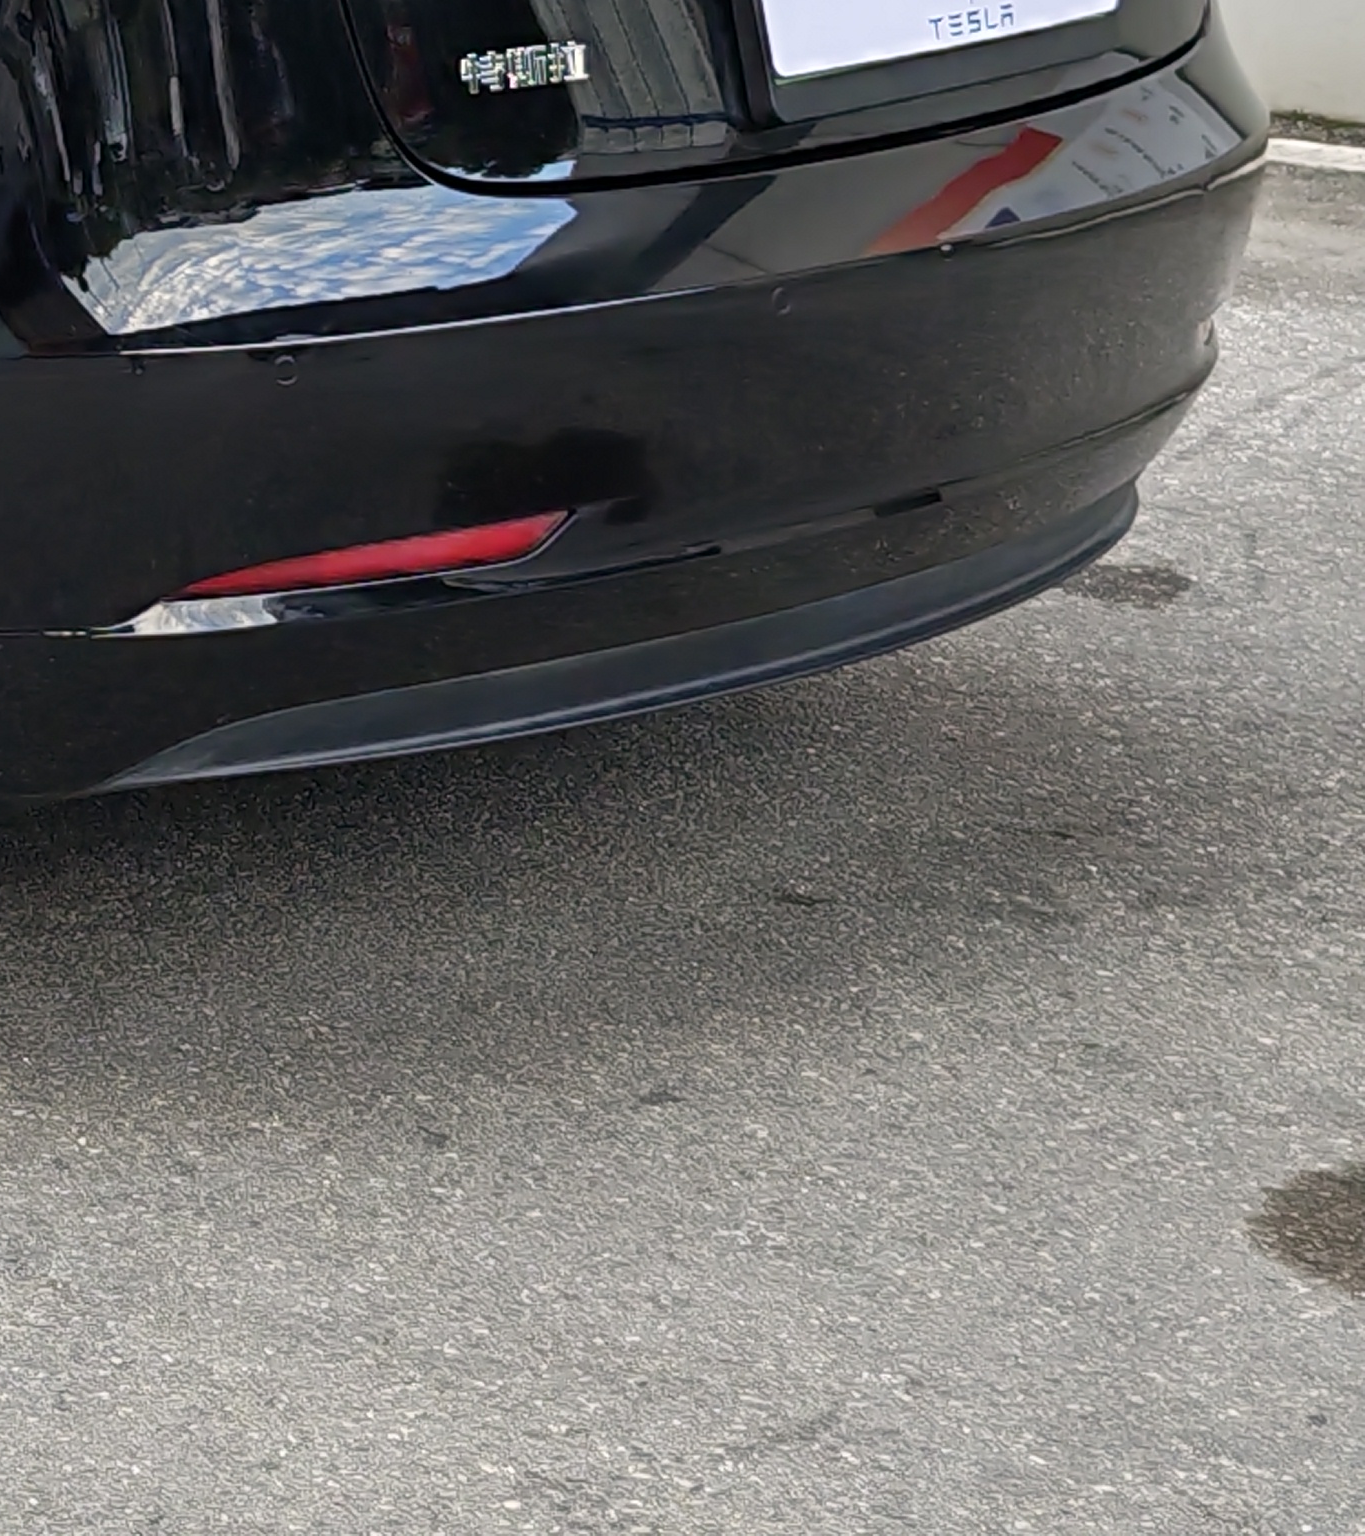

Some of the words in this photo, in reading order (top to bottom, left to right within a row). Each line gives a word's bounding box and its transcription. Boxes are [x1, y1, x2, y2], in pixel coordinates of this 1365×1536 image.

[928, 3, 1014, 41] TESLA
[460, 41, 589, 95] 特斯拉
